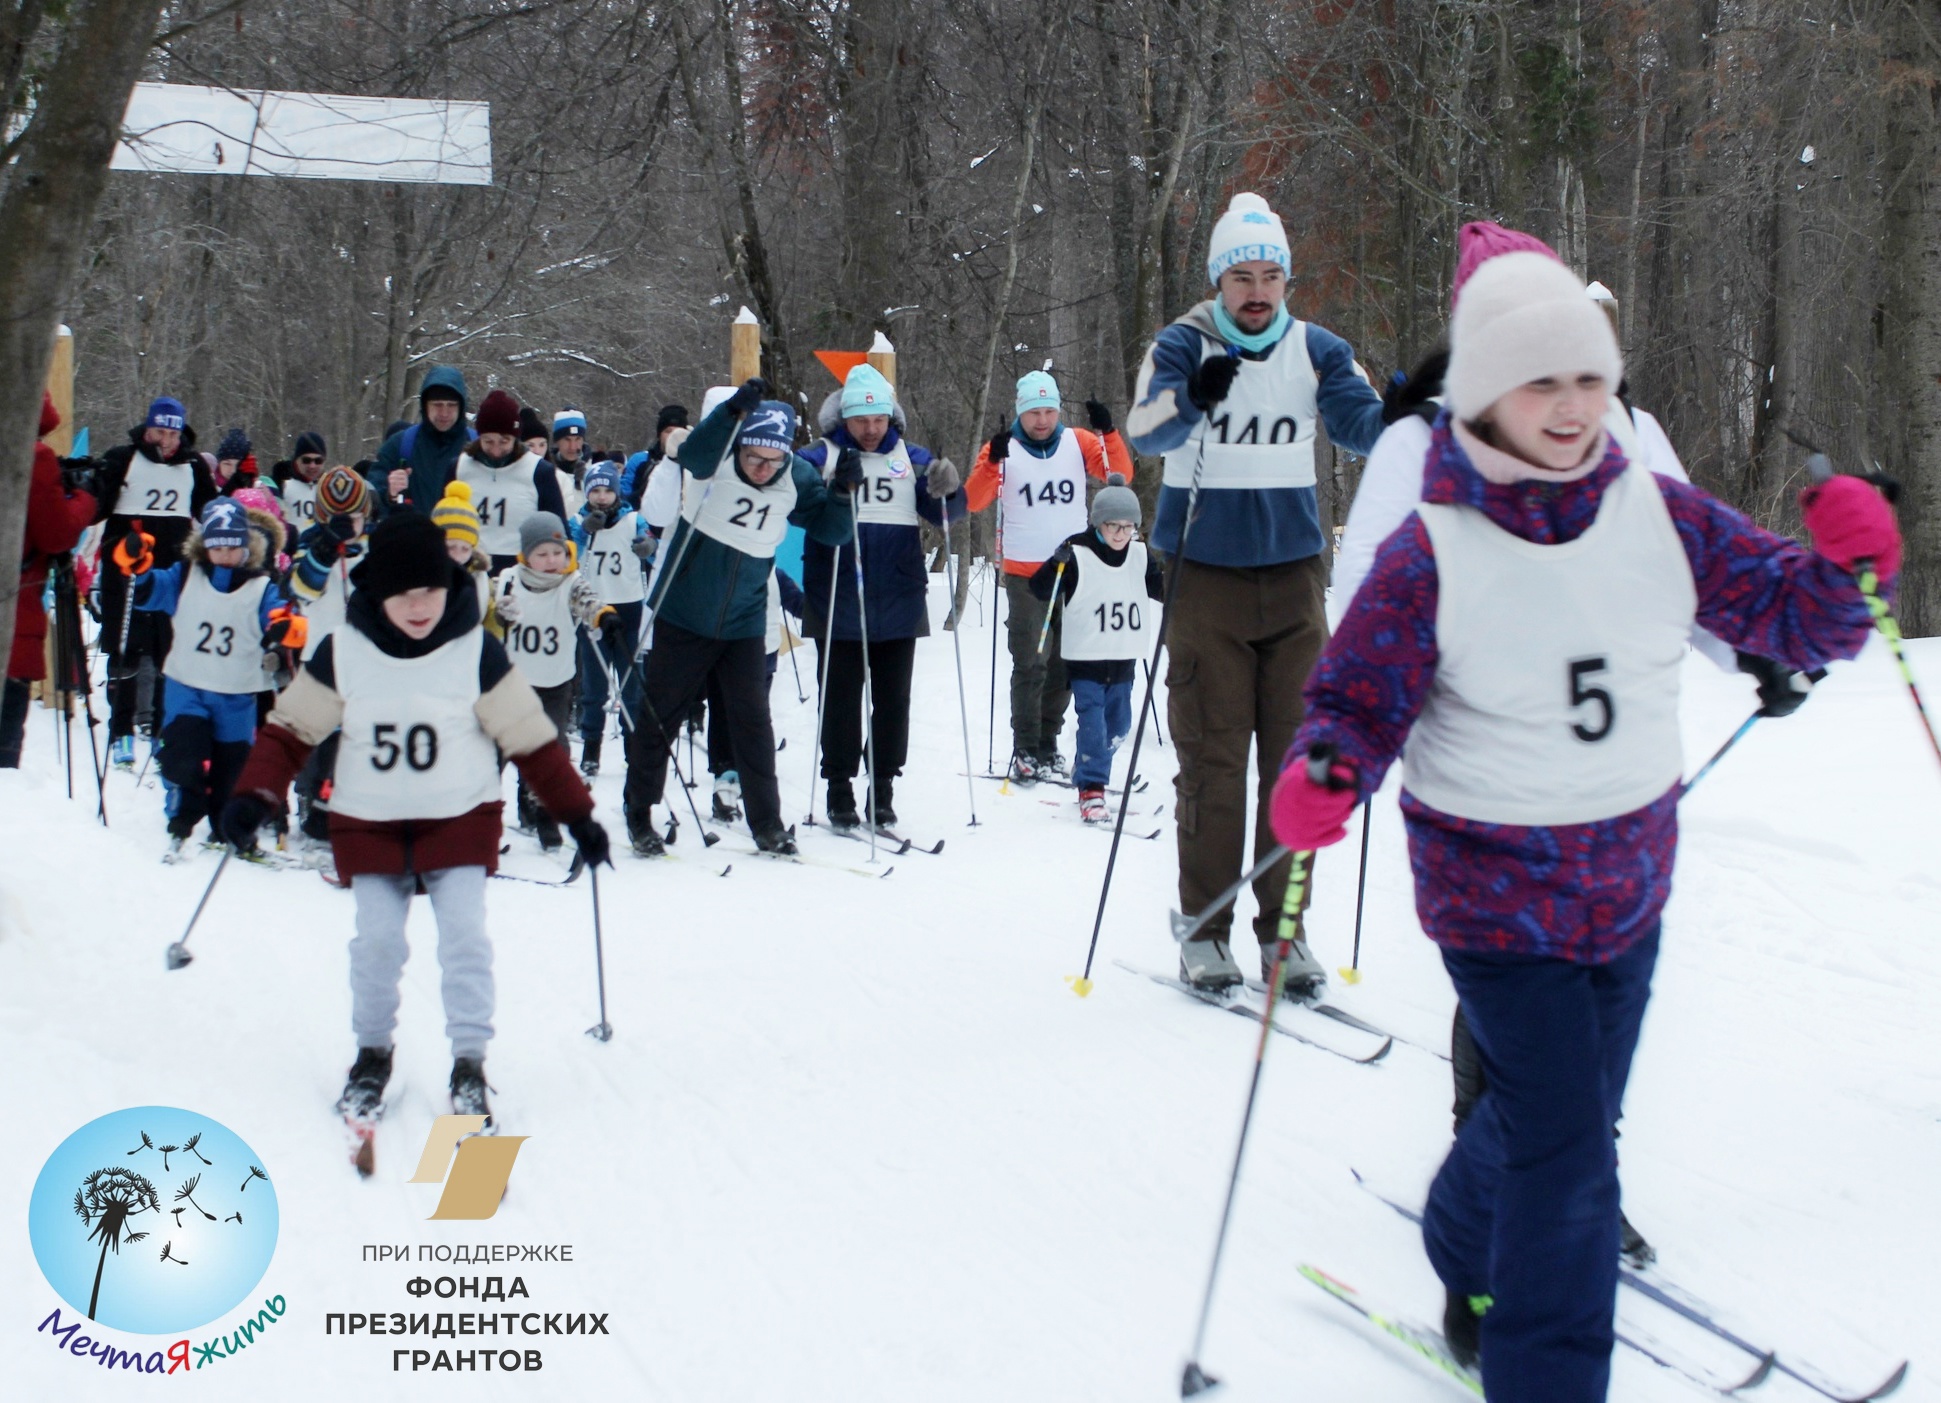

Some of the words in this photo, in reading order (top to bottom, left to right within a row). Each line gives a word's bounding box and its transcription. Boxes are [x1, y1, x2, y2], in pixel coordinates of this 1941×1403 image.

[1211, 412, 1299, 446] 140
[145, 488, 179, 512] 22
[858, 476, 895, 504] 15
[1018, 479, 1075, 507] 149
[475, 496, 508, 527] 41
[728, 497, 772, 531] 21
[593, 550, 622, 576] 73
[1094, 602, 1141, 633] 150
[195, 621, 235, 658] 23
[511, 622, 561, 656] 103
[1566, 656, 1617, 743] 5
[370, 723, 439, 773] 50
